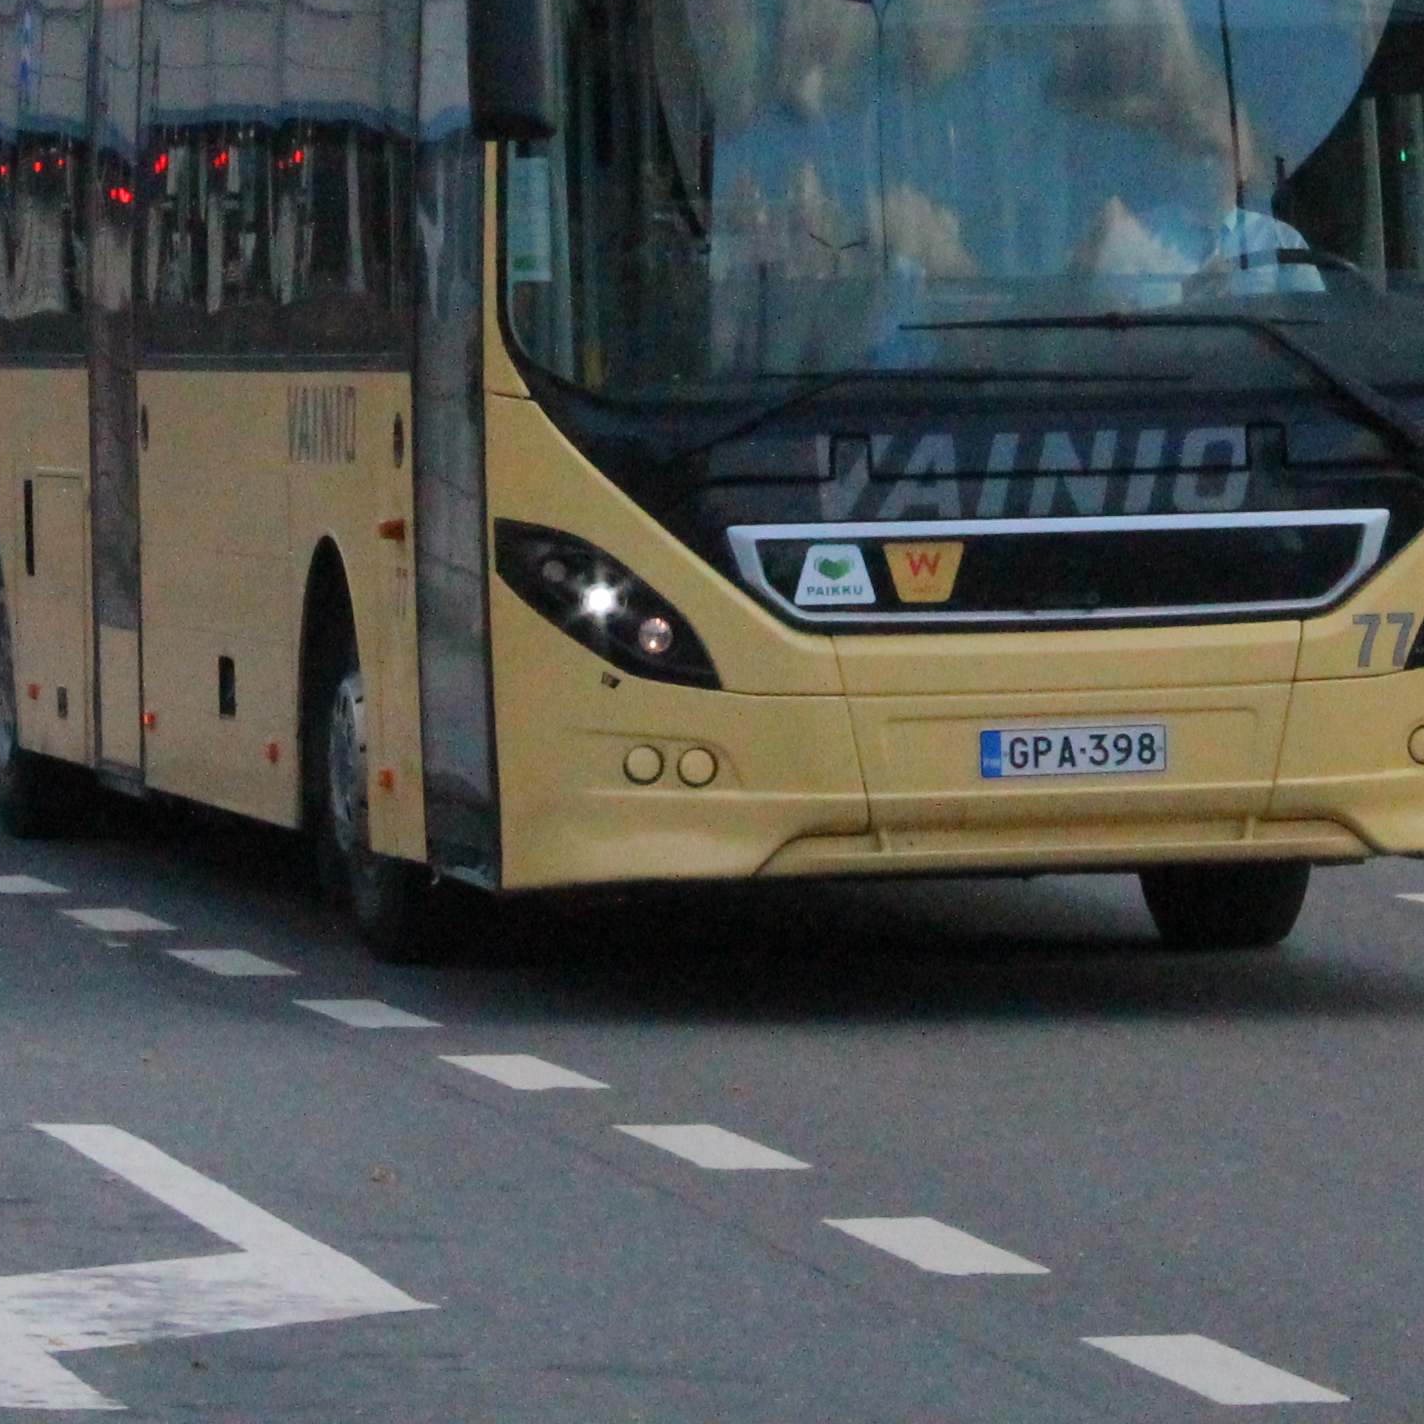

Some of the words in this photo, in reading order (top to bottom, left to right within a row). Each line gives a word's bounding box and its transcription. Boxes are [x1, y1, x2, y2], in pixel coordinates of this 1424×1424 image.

[815, 425, 1250, 521] VAINIO
[806, 584, 864, 597] PAIKKU
[1352, 612, 1415, 668] 77
[1008, 732, 1157, 770] GPA-398
